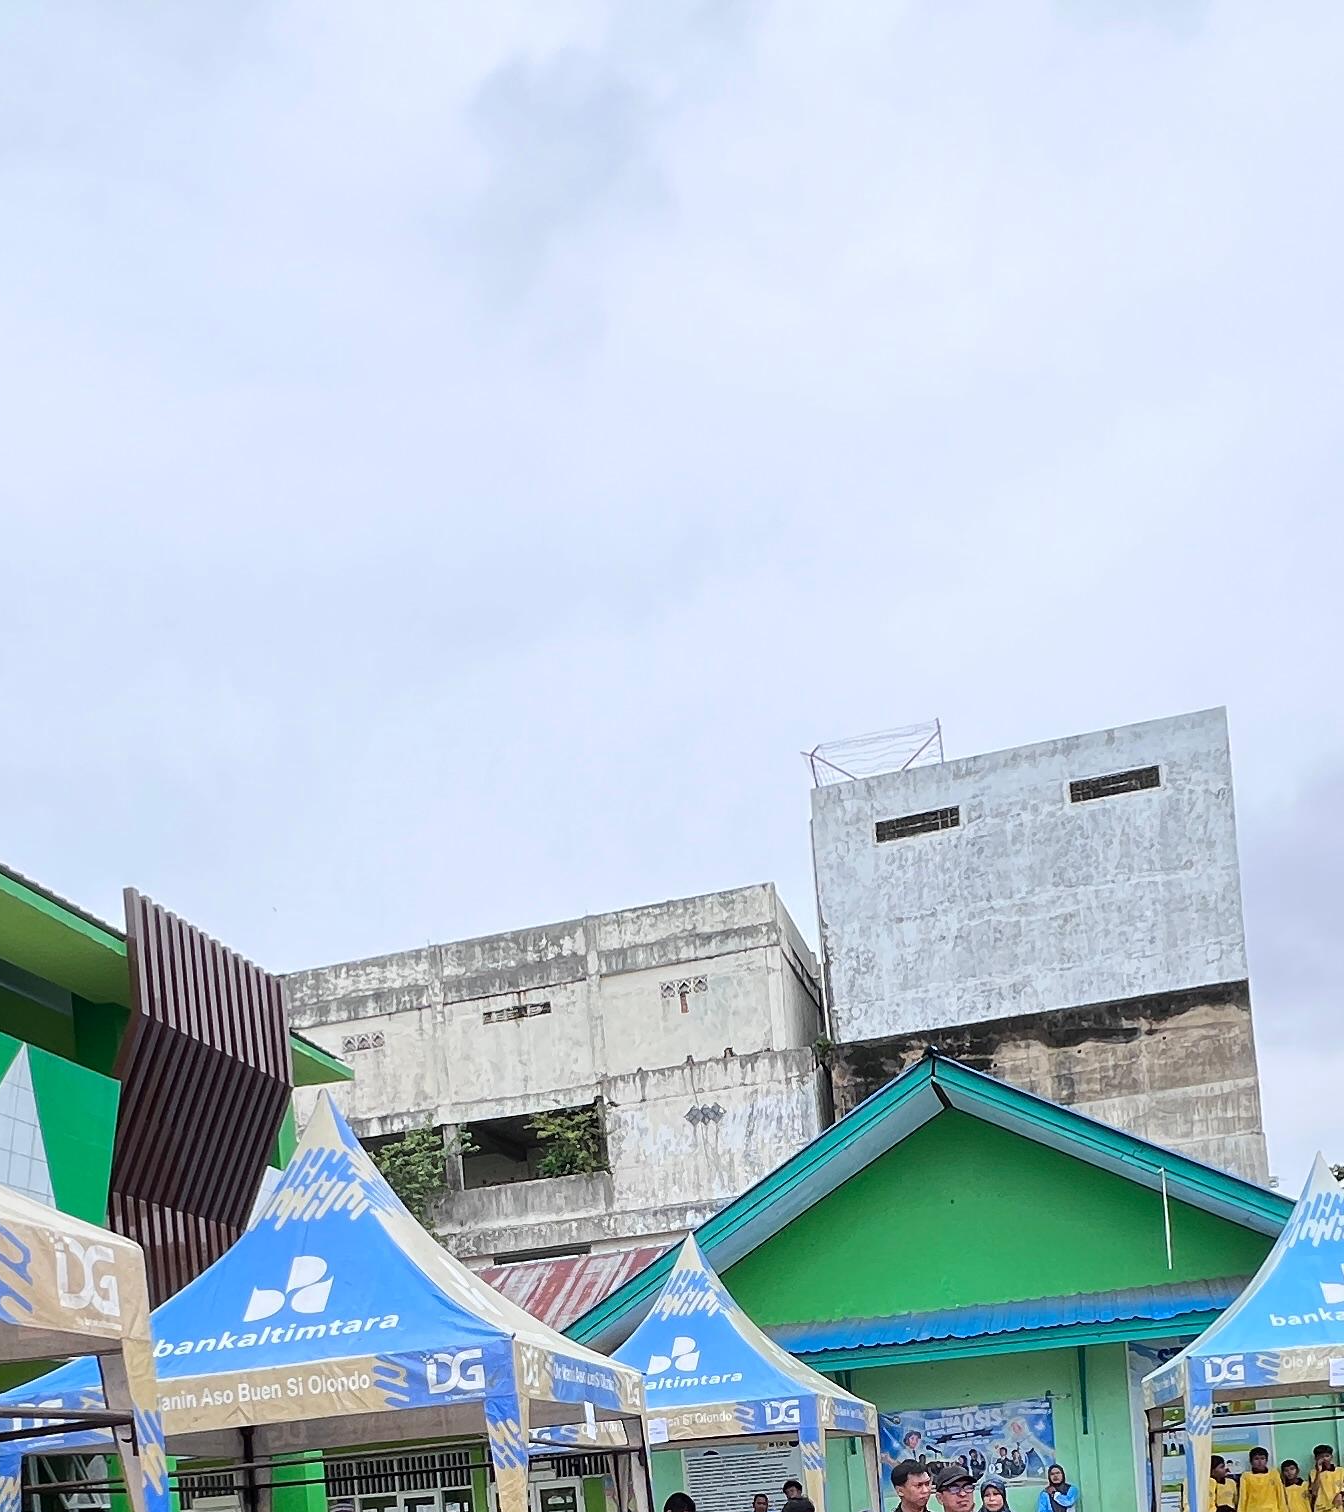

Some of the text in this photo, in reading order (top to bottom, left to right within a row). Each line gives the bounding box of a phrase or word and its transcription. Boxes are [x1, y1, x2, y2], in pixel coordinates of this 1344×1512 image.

[153, 1313, 400, 1359] bankaltimtara
[158, 1371, 371, 1412] anin Aso Buen Si Olondo
[645, 1371, 744, 1391] altimtara
[695, 1410, 733, 1424] Olondo
[962, 1407, 1006, 1431] OSIS
[988, 1462, 1003, 1474] 03
